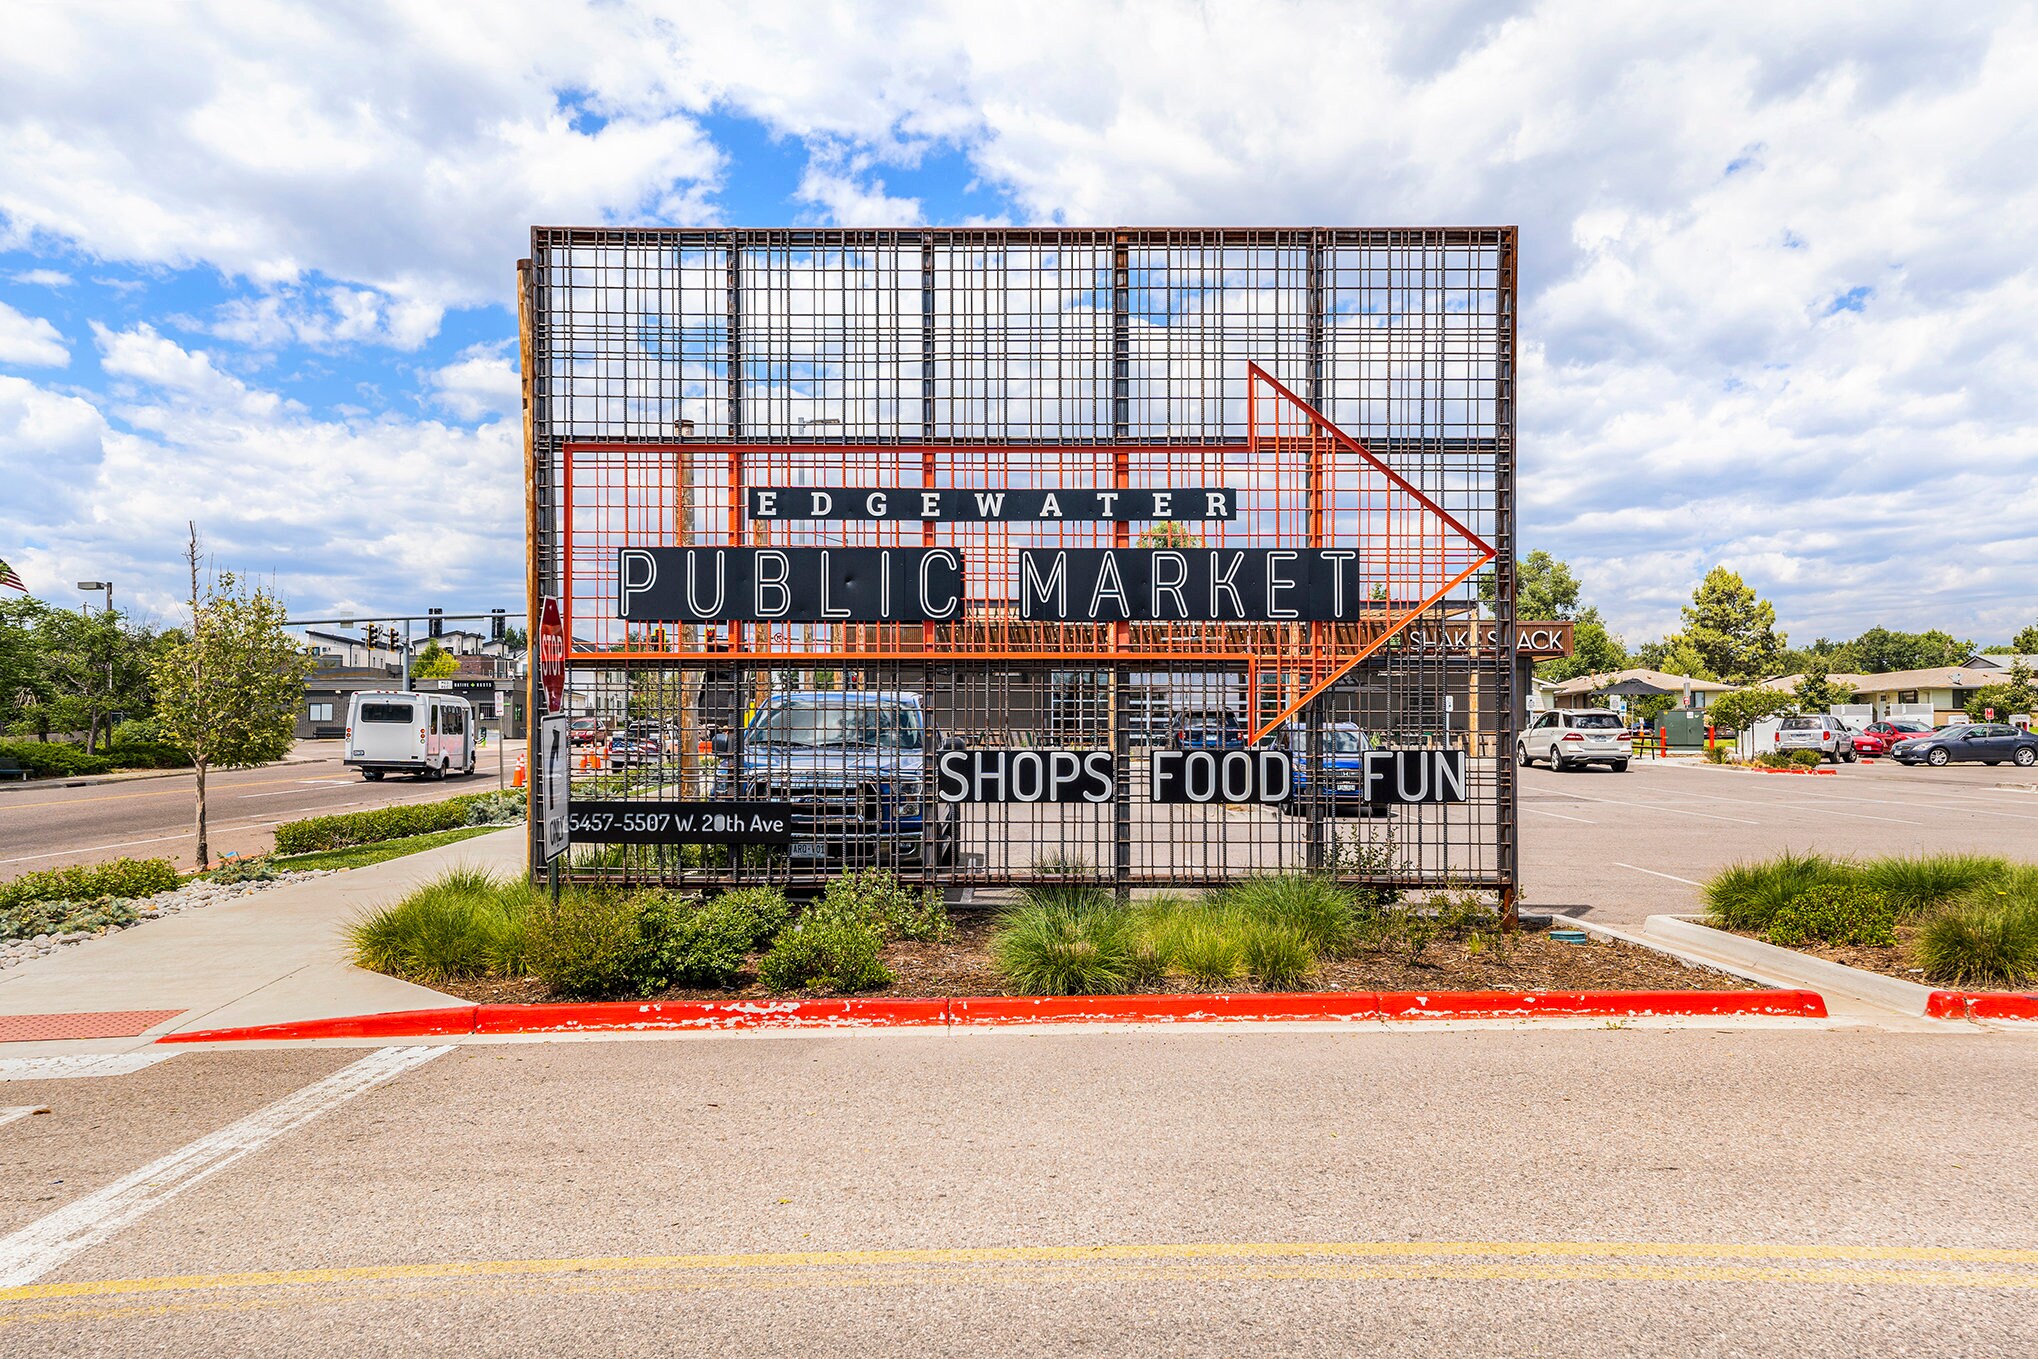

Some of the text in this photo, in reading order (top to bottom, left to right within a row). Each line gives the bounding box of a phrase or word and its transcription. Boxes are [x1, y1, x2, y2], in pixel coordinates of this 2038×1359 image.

[757, 491, 1228, 517] EDGEWATER
[620, 548, 1357, 619] PUBLIC MARKET
[542, 634, 563, 676] STOP
[1410, 630, 1564, 650] SHAK SACK
[938, 751, 1467, 803] SHOPS FOOD FUN
[569, 813, 784, 832] 5457-5507 W. 20th Ave
